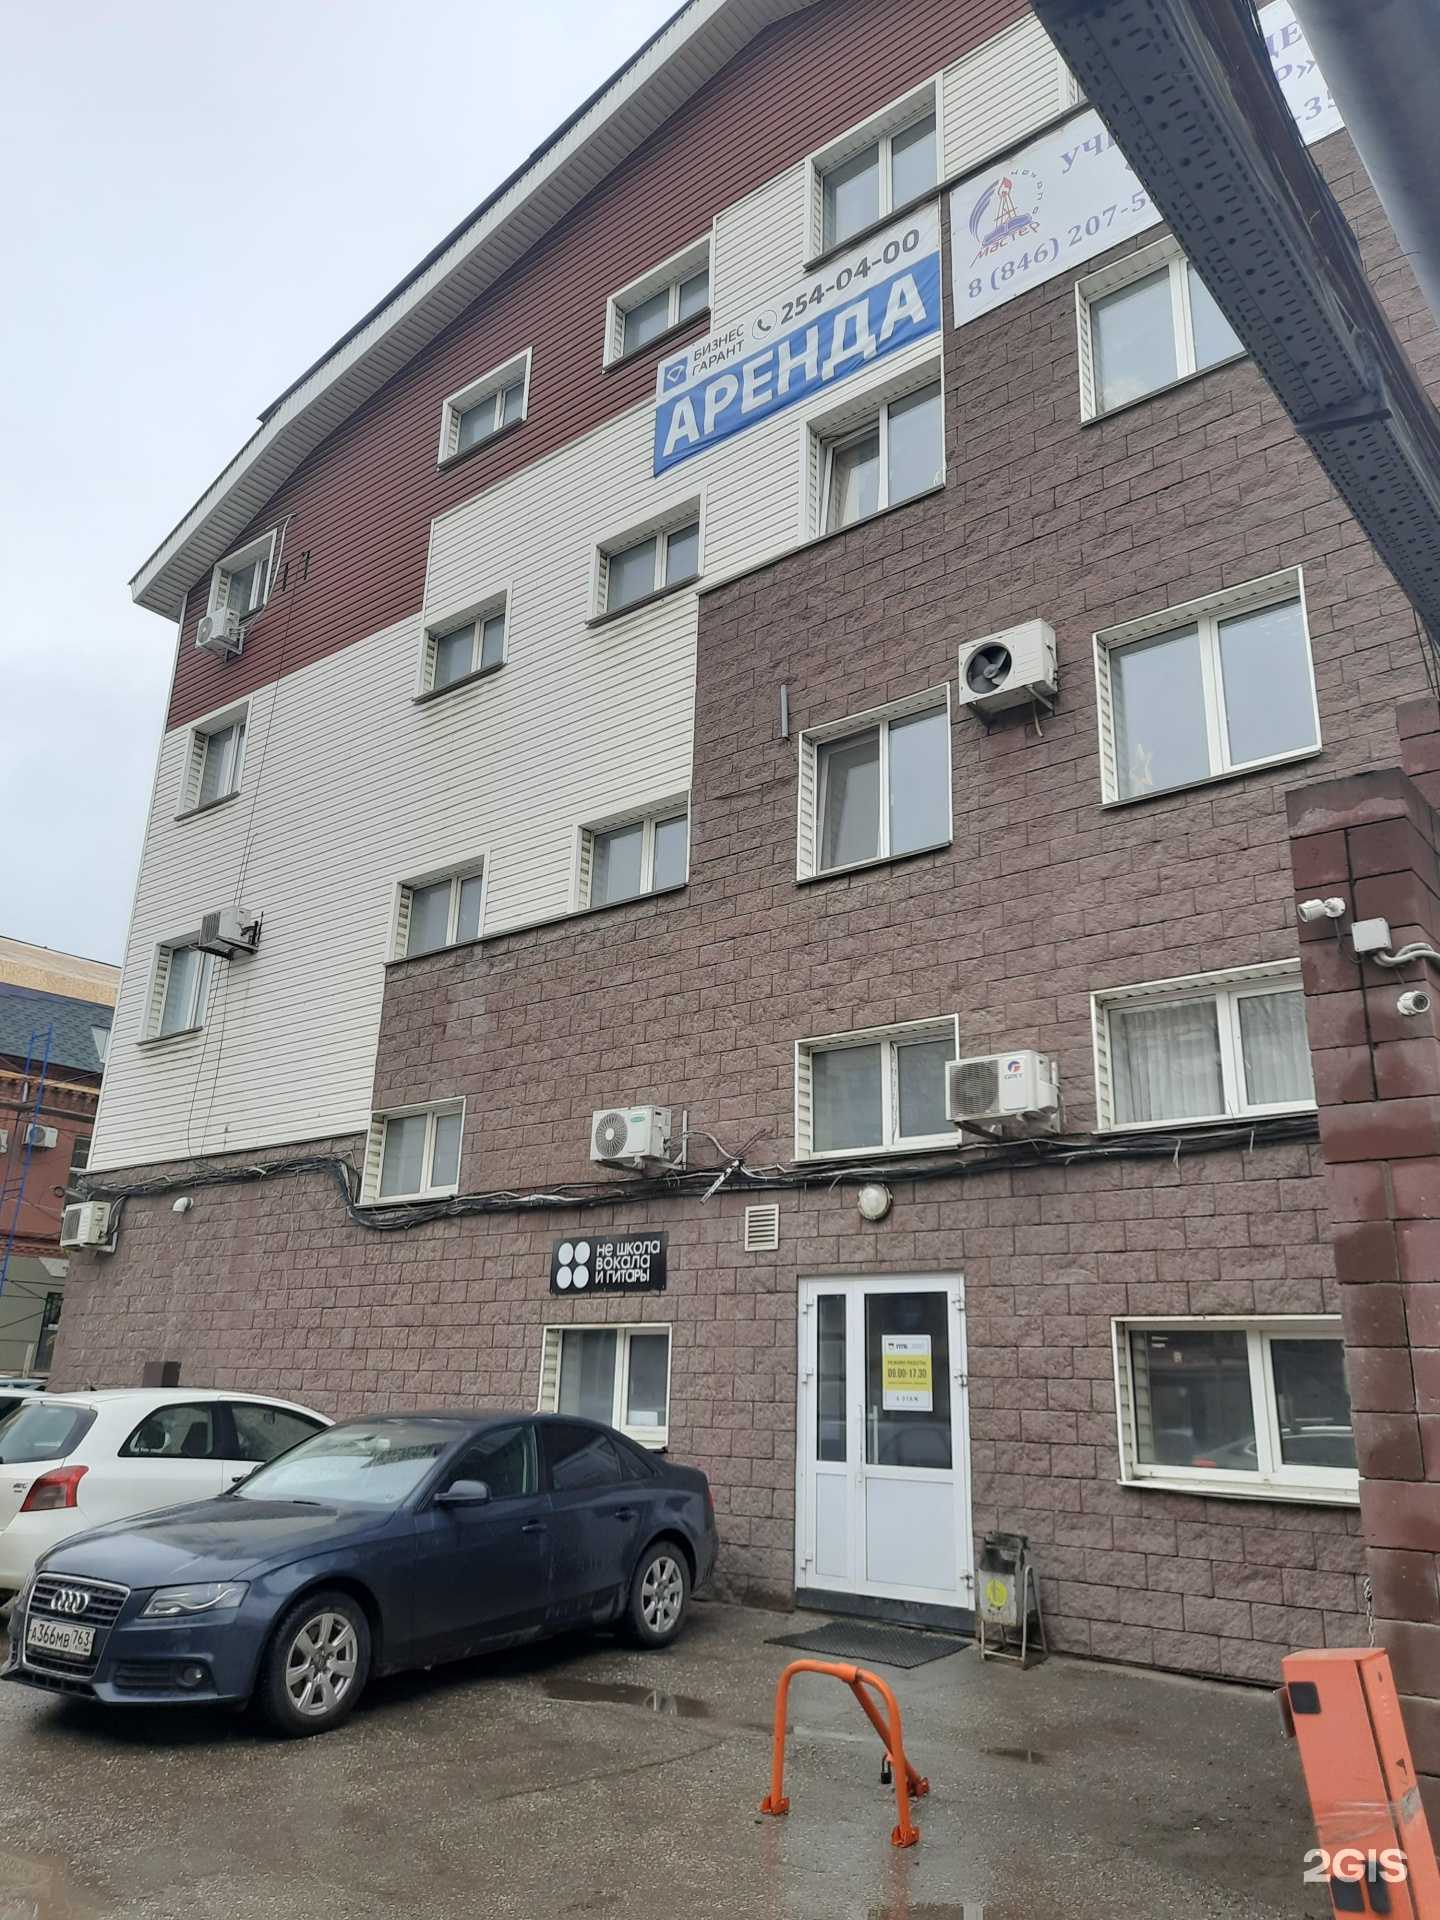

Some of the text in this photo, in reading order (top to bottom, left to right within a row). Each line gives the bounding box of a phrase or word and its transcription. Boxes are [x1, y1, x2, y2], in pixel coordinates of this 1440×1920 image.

[780, 228, 920, 325] 254-04-00
[968, 279, 982, 298] 8
[990, 238, 1059, 290] (846)
[1067, 188, 1147, 247] 207-5
[662, 272, 927, 457] АРЕНДА
[692, 339, 745, 376] ГАРАНТ
[693, 324, 745, 361] БИЗНЕС
